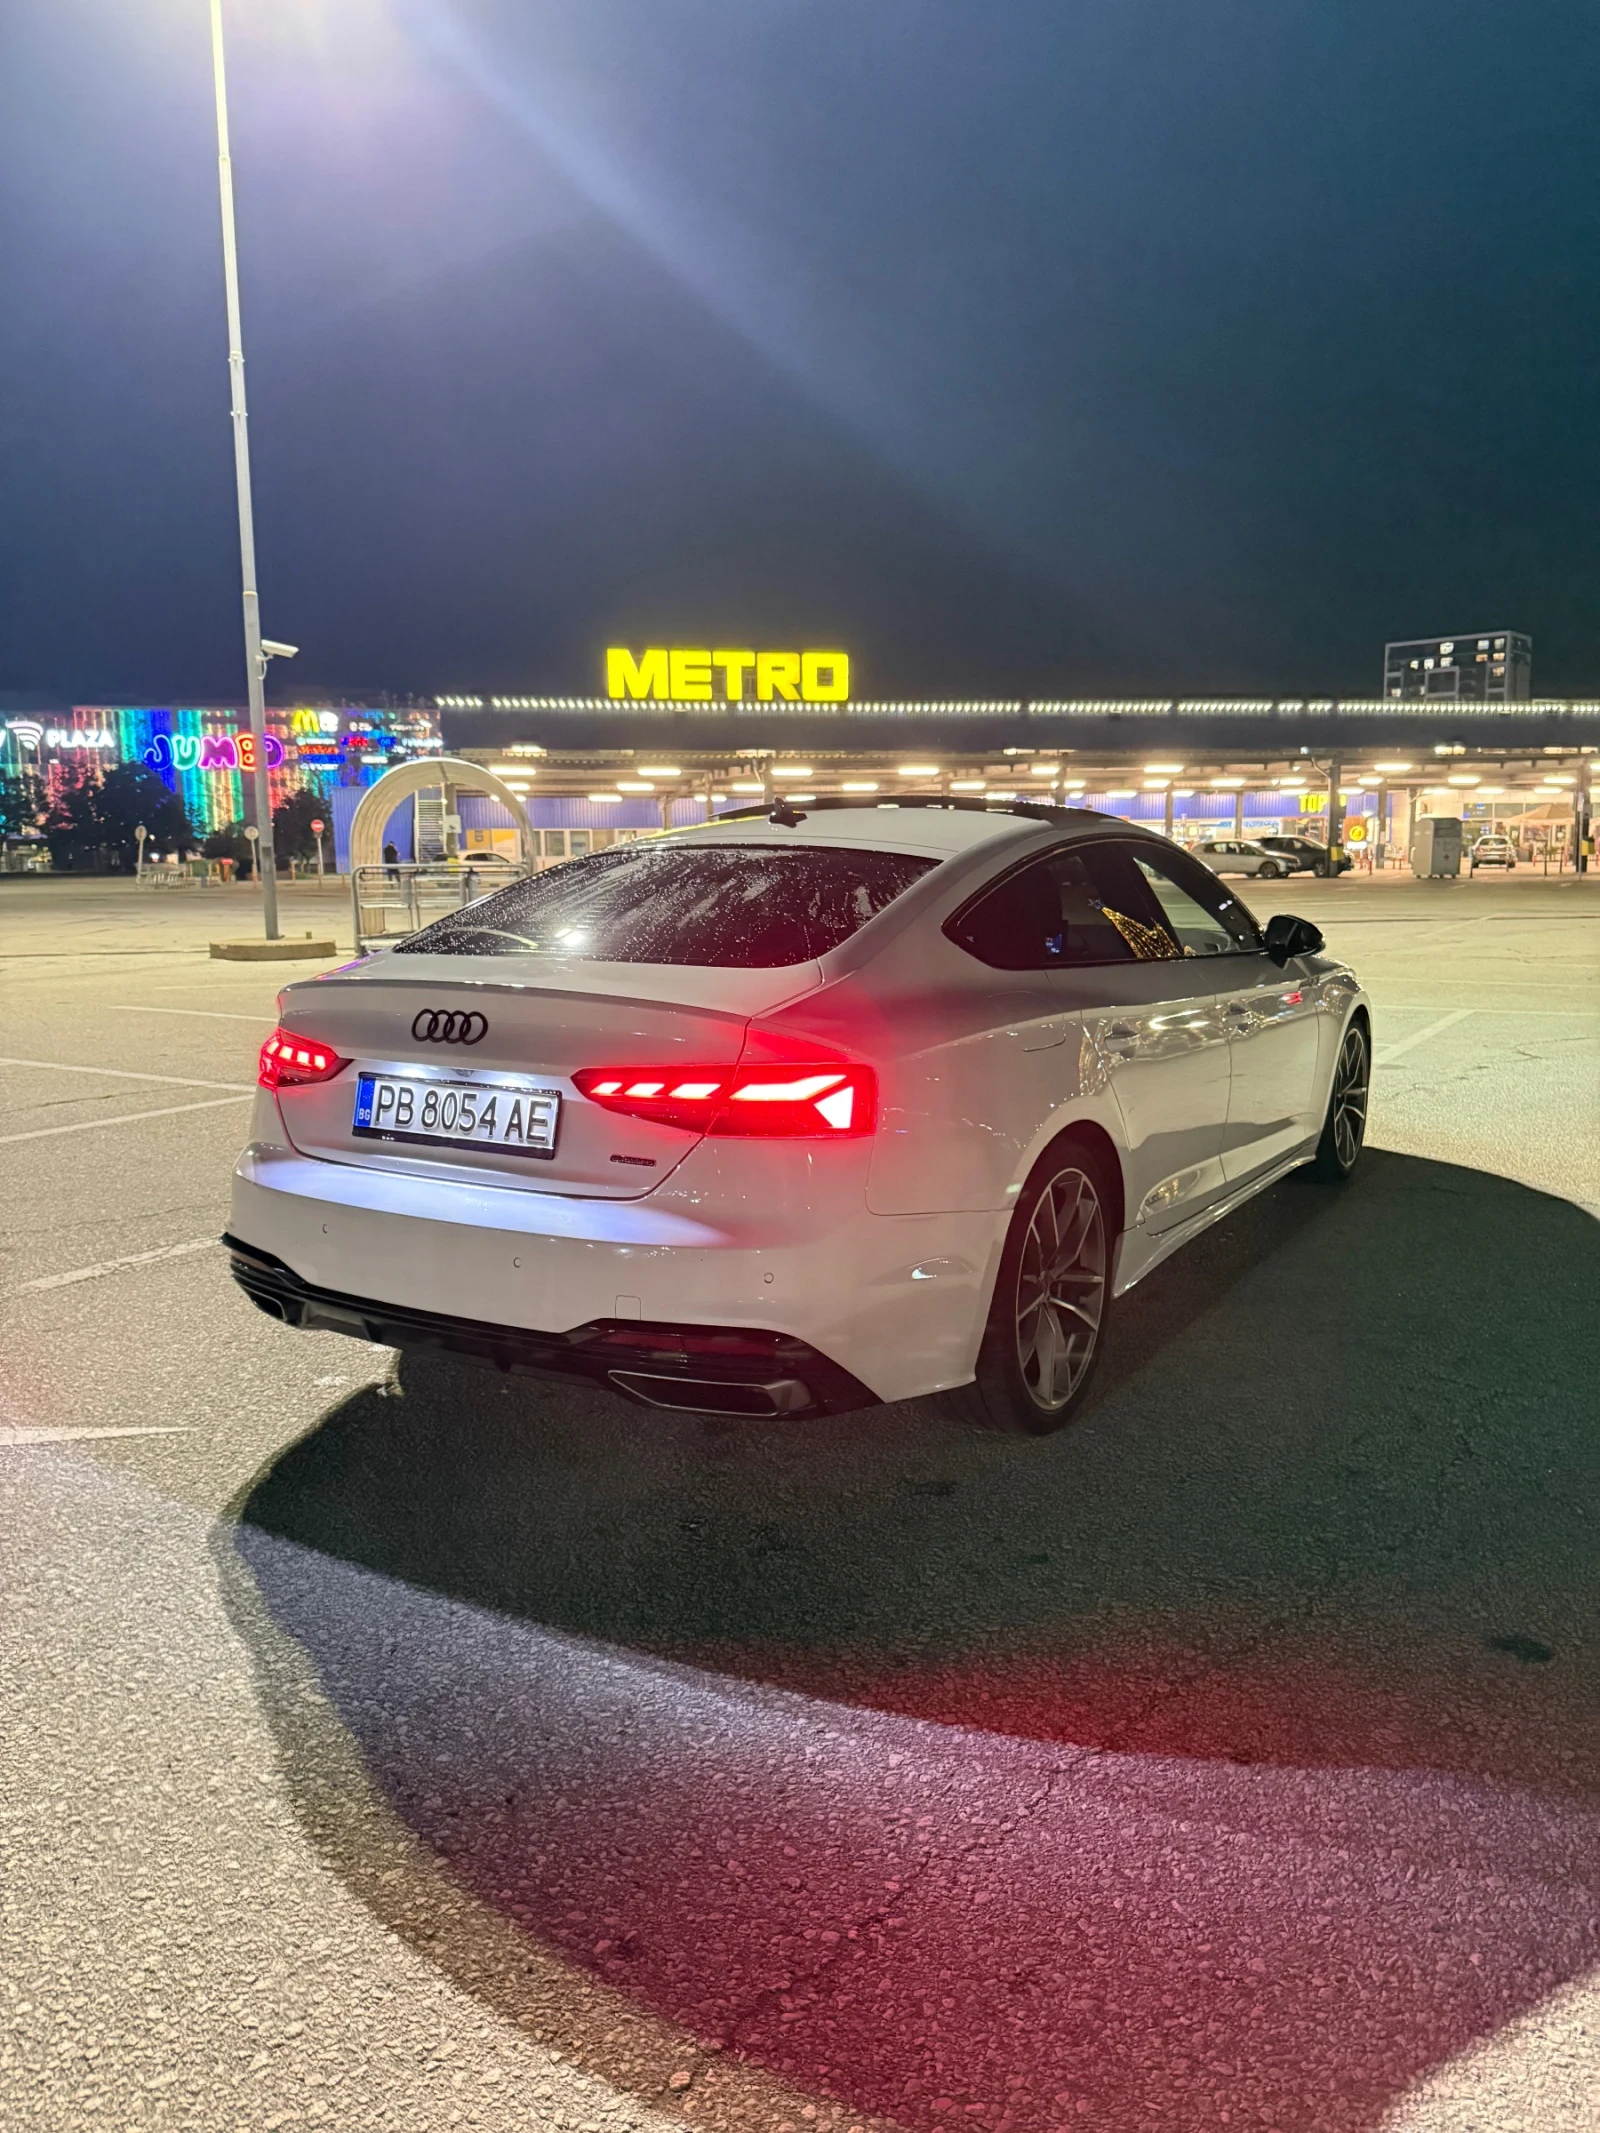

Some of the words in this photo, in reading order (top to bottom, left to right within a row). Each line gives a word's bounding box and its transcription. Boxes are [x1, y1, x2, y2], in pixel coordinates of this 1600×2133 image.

[606, 648, 849, 701] METRO
[45, 729, 115, 748] PLAZA
[143, 733, 284, 772] JUMBO
[358, 1108, 371, 1121] BG
[375, 1084, 414, 1126] PB
[421, 1090, 497, 1137] 8054
[504, 1098, 551, 1142] AE
